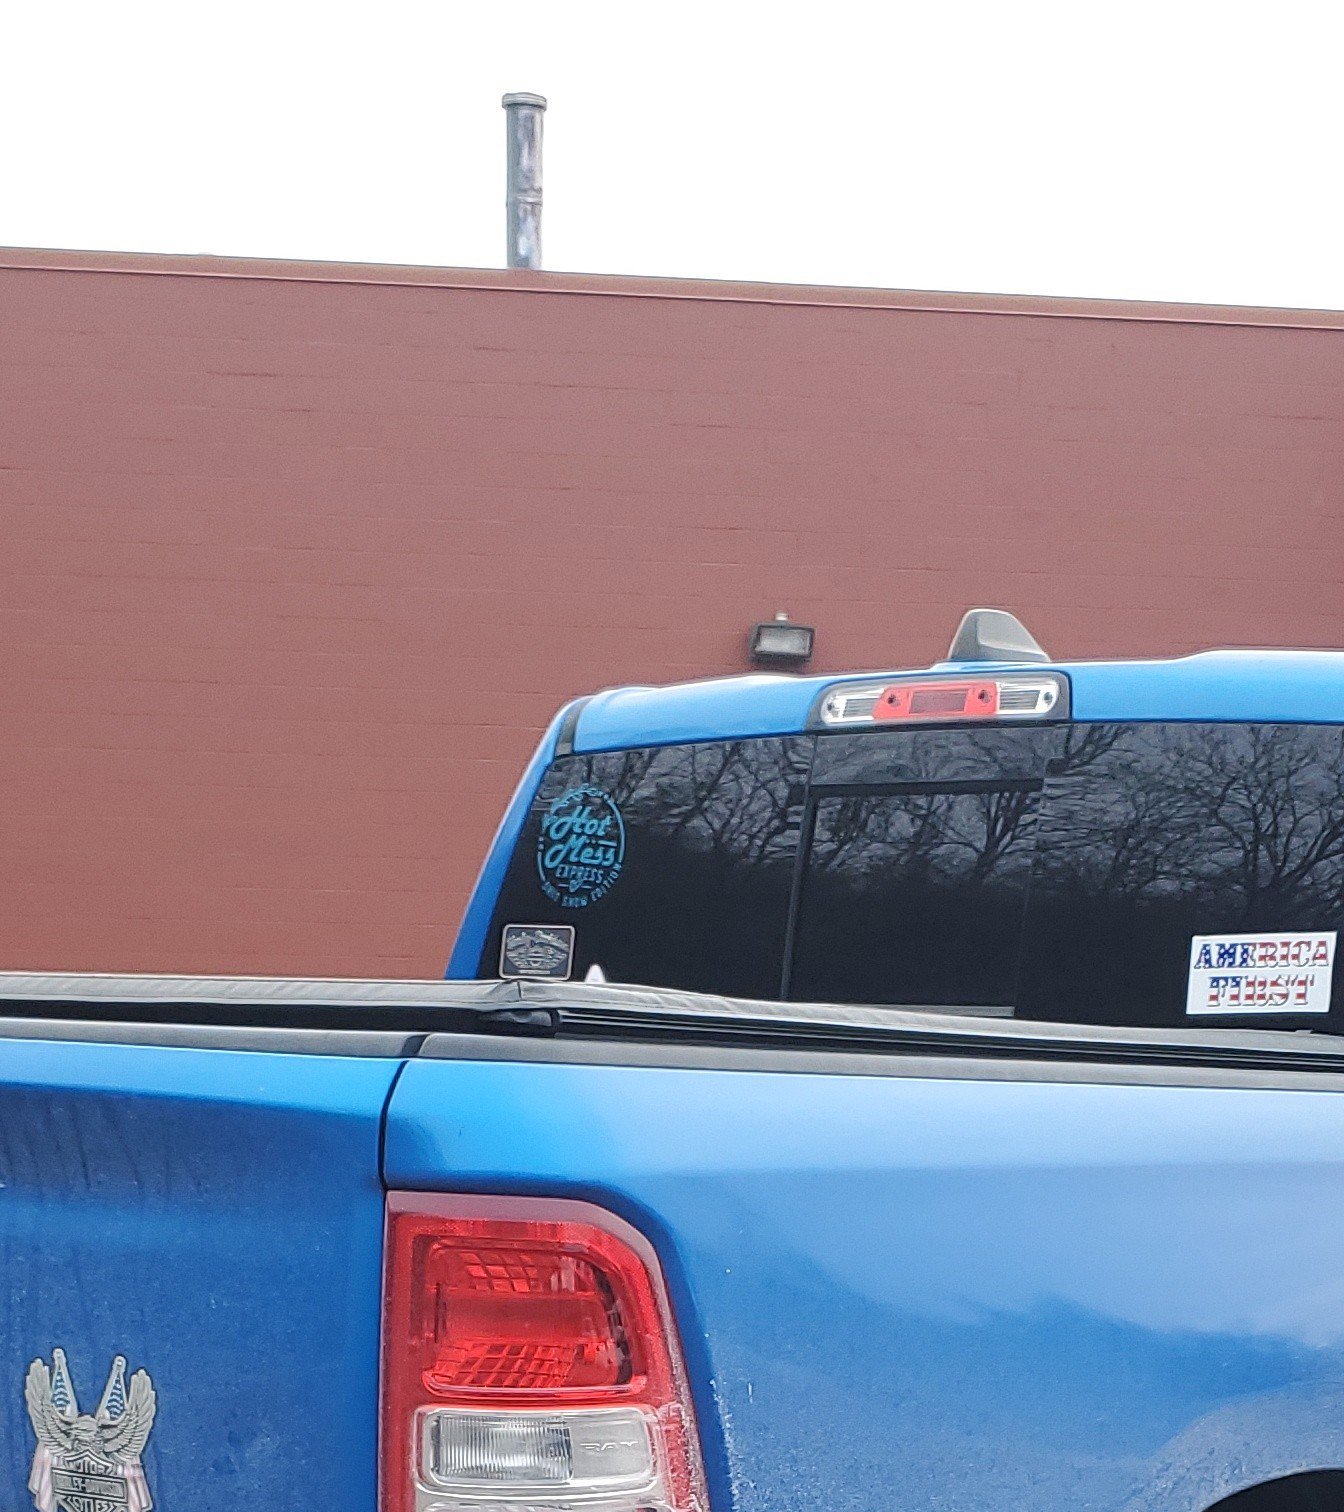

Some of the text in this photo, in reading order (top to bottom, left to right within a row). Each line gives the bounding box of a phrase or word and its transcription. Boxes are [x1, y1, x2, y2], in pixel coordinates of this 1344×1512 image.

[549, 806, 612, 840] Hot
[545, 834, 616, 868] Mess
[1193, 940, 1329, 969] AMERICA
[1207, 974, 1315, 1008] FIRST
